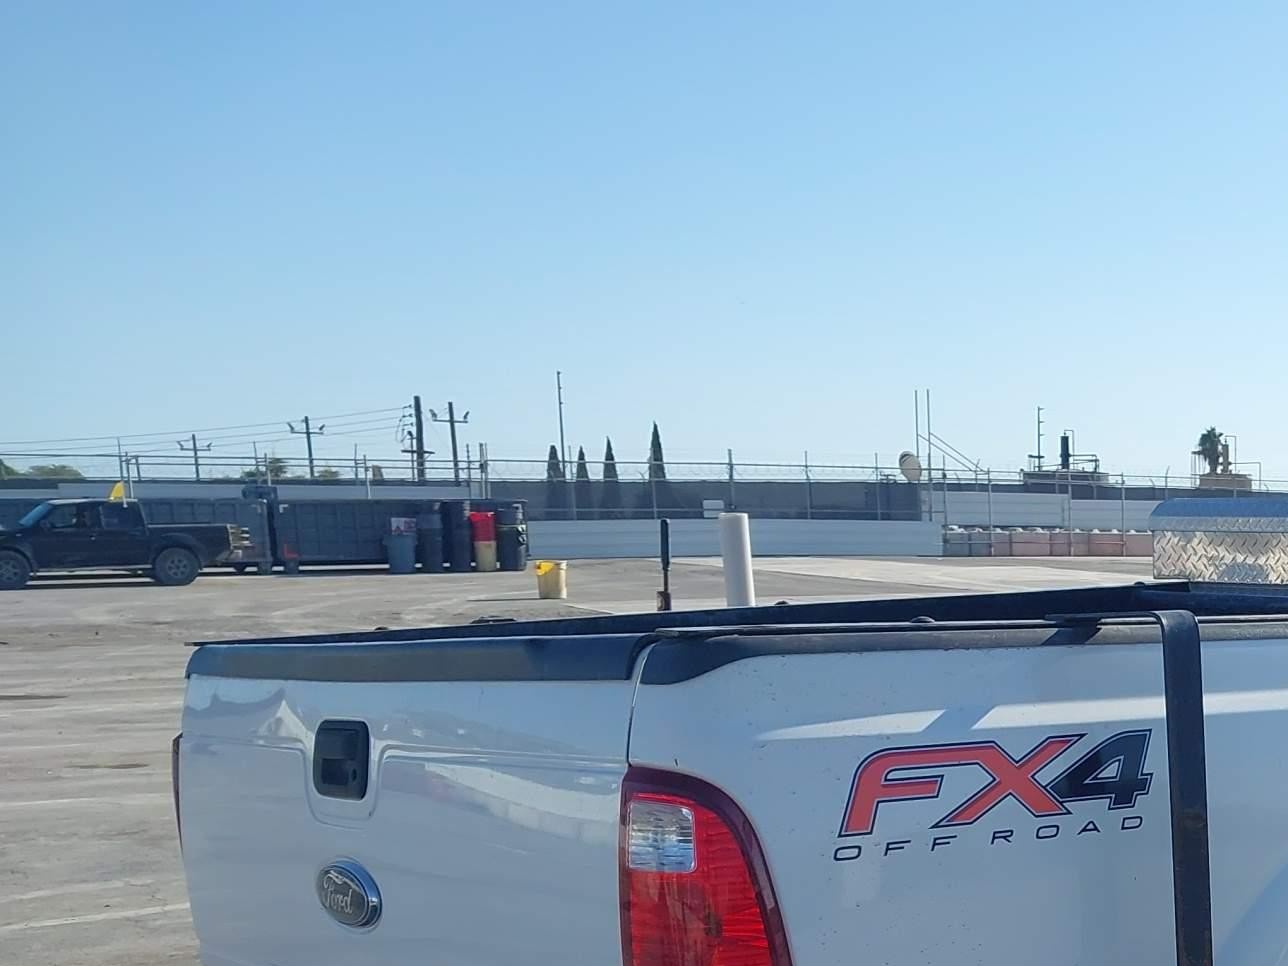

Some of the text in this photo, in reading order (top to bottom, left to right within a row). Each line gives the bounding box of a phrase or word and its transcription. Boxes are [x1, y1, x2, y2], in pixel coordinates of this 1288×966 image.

[837, 728, 1154, 838] FX4
[833, 815, 1144, 862] OFF ROAD
[323, 870, 354, 914] Ford
